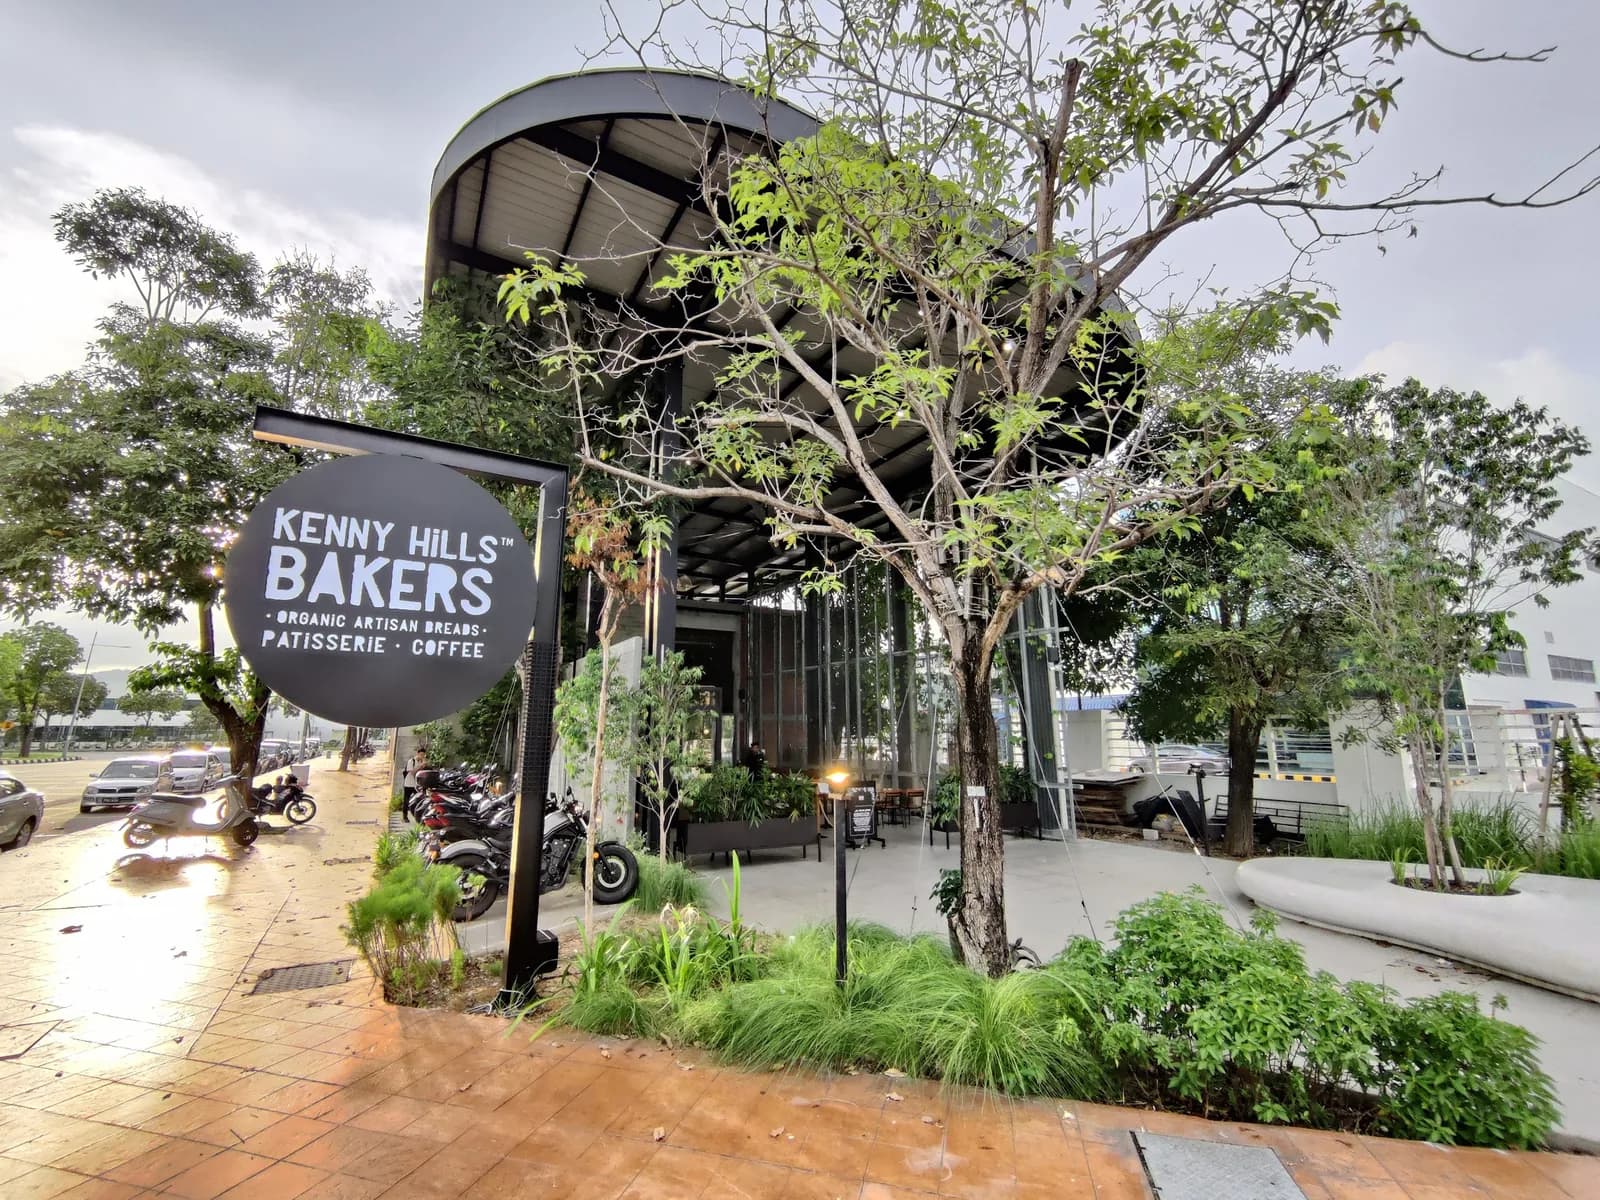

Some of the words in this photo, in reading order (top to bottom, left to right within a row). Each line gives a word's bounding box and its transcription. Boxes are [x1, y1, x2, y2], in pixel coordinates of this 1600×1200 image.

[272, 506, 395, 552] KENNY
[264, 545, 494, 616] BAKERS
[425, 620, 480, 637] BREADS
[412, 638, 485, 659] COFFEE
